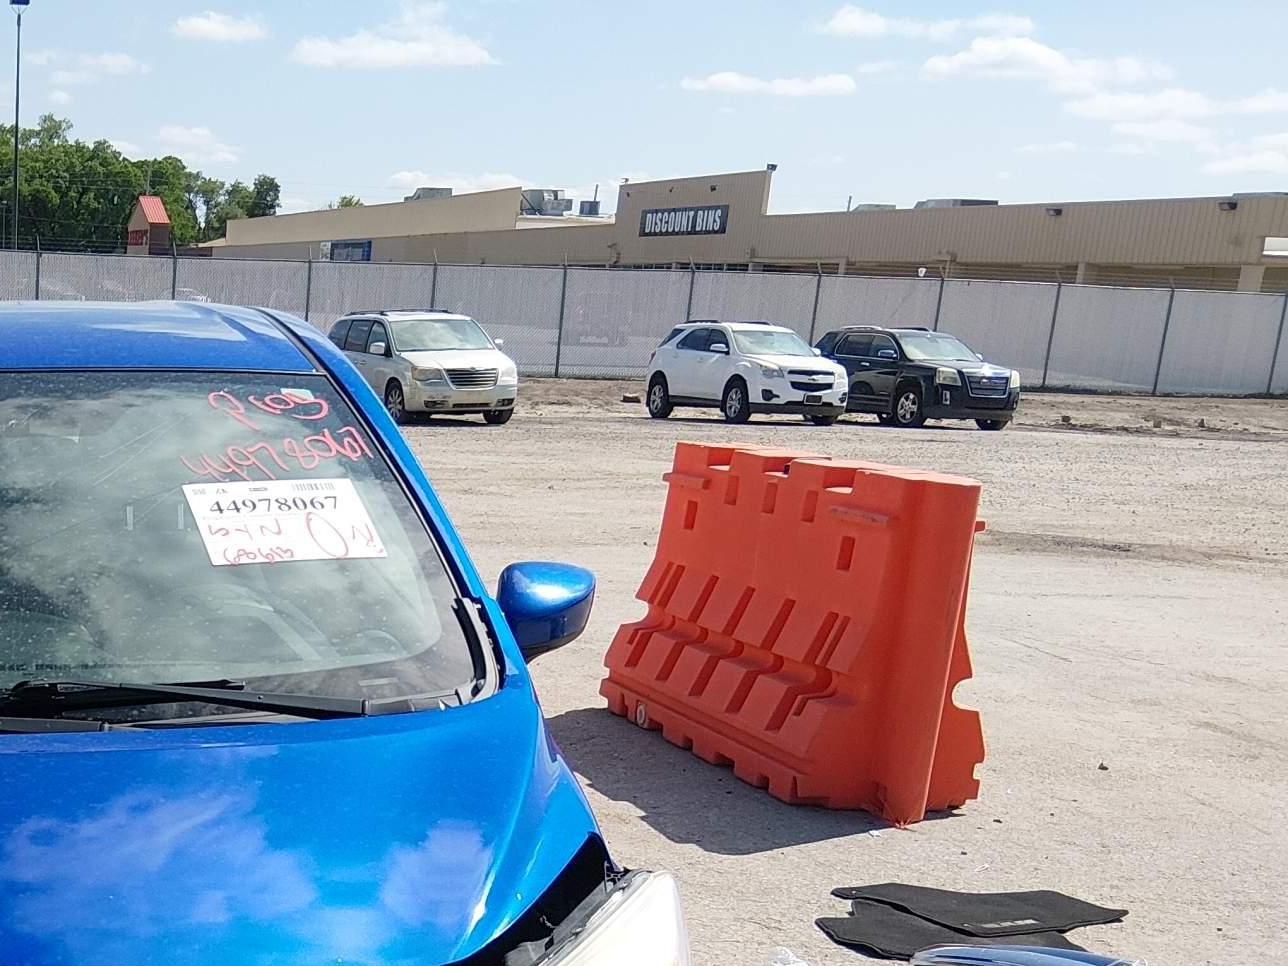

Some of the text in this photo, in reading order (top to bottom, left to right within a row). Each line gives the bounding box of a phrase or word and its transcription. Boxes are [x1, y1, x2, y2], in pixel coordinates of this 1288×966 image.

[644, 208, 722, 233] DISCOUNT BINS
[209, 495, 338, 515] 44978067
